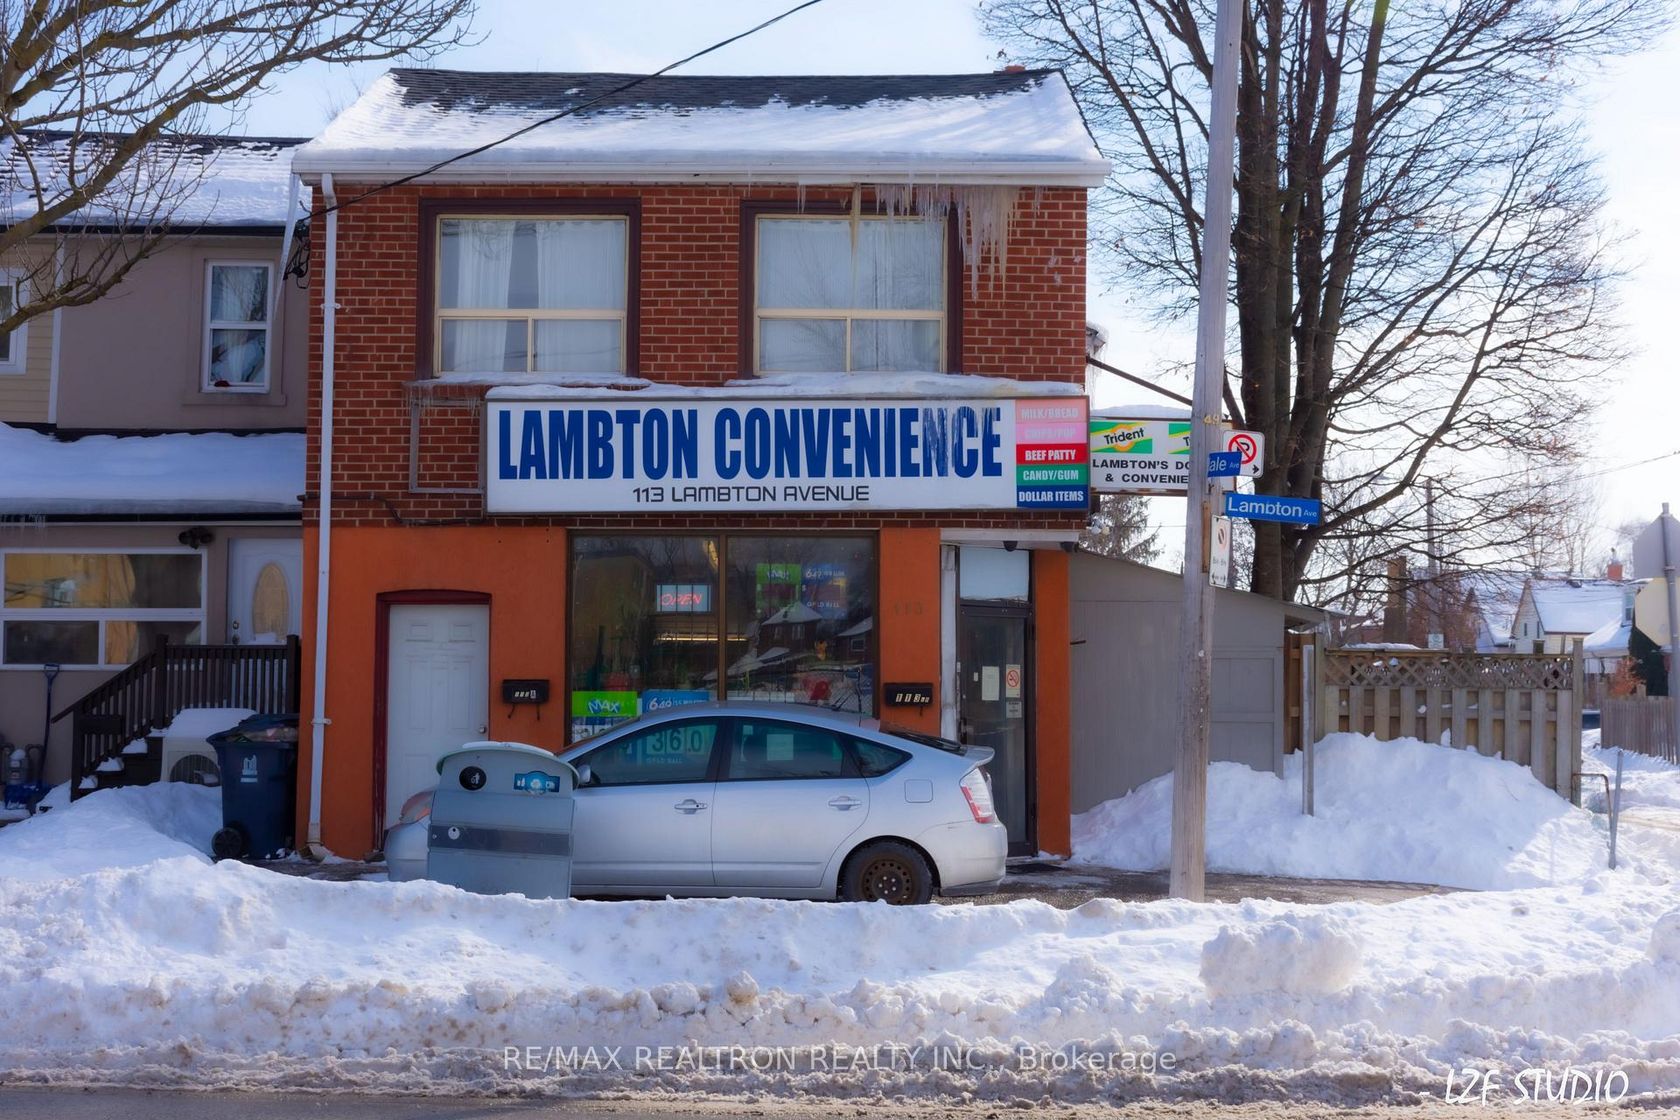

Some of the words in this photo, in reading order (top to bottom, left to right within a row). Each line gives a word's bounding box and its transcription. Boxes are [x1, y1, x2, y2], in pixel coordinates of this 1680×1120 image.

[499, 408, 698, 480] LAMBTON
[714, 406, 1002, 480] CONVENIENCE
[1104, 427, 1145, 445] Trident
[1025, 449, 1047, 461] BEEF
[1048, 449, 1076, 461] PATTY
[1092, 459, 1169, 470] LAMBTON'S
[1023, 469, 1079, 482] CANDY/GUM
[1105, 473, 1114, 483] &
[633, 486, 664, 503] 113
[672, 485, 776, 503] LAMBTON
[784, 485, 869, 502] AVENUE
[1019, 490, 1054, 503] DOLLAR
[1055, 489, 1084, 502] ITEMS
[1228, 496, 1302, 518] Lambton
[1303, 509, 1318, 518] Ave
[661, 593, 702, 606] OPEN
[588, 698, 621, 714] MAX
